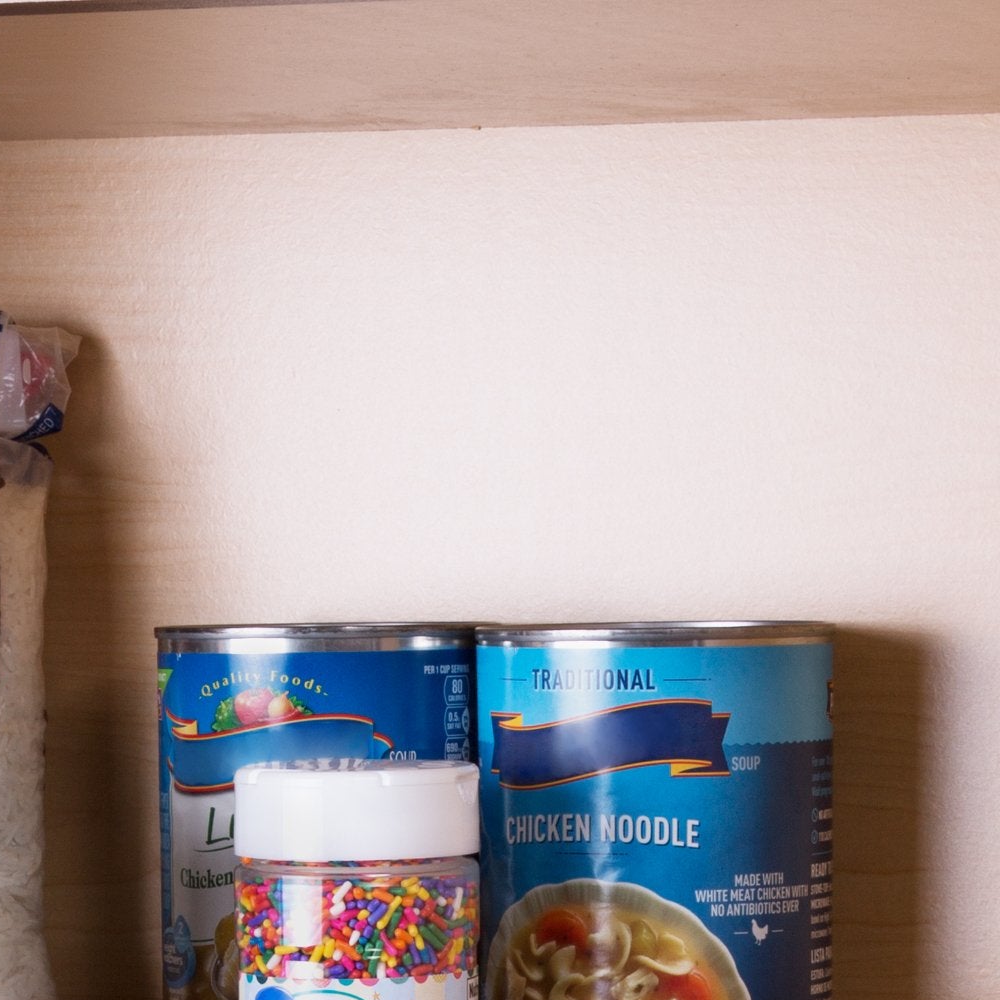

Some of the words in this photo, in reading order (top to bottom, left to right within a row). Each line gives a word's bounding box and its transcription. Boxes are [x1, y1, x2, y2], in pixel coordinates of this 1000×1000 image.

[424, 665, 435, 674] PER
[440, 665, 450, 674] CUP
[201, 671, 261, 696] Quality
[270, 670, 322, 693] Foods
[452, 679, 463, 693] 80
[532, 668, 656, 691] TRADITIONAL
[731, 755, 761, 771] SOUP
[506, 814, 591, 846] CHICKEN
[600, 815, 700, 849] NOODLE
[180, 867, 234, 889] Chicken
[734, 874, 761, 887] MADE
[762, 872, 784, 885] WITH
[695, 889, 728, 903] WHITE
[730, 888, 755, 902] MEAT
[757, 886, 791, 900] CHICKEN
[791, 884, 809, 897] WITH
[711, 904, 725, 917] NO
[726, 901, 781, 916] ANTIBIOTICS
[781, 900, 799, 913] EVER
